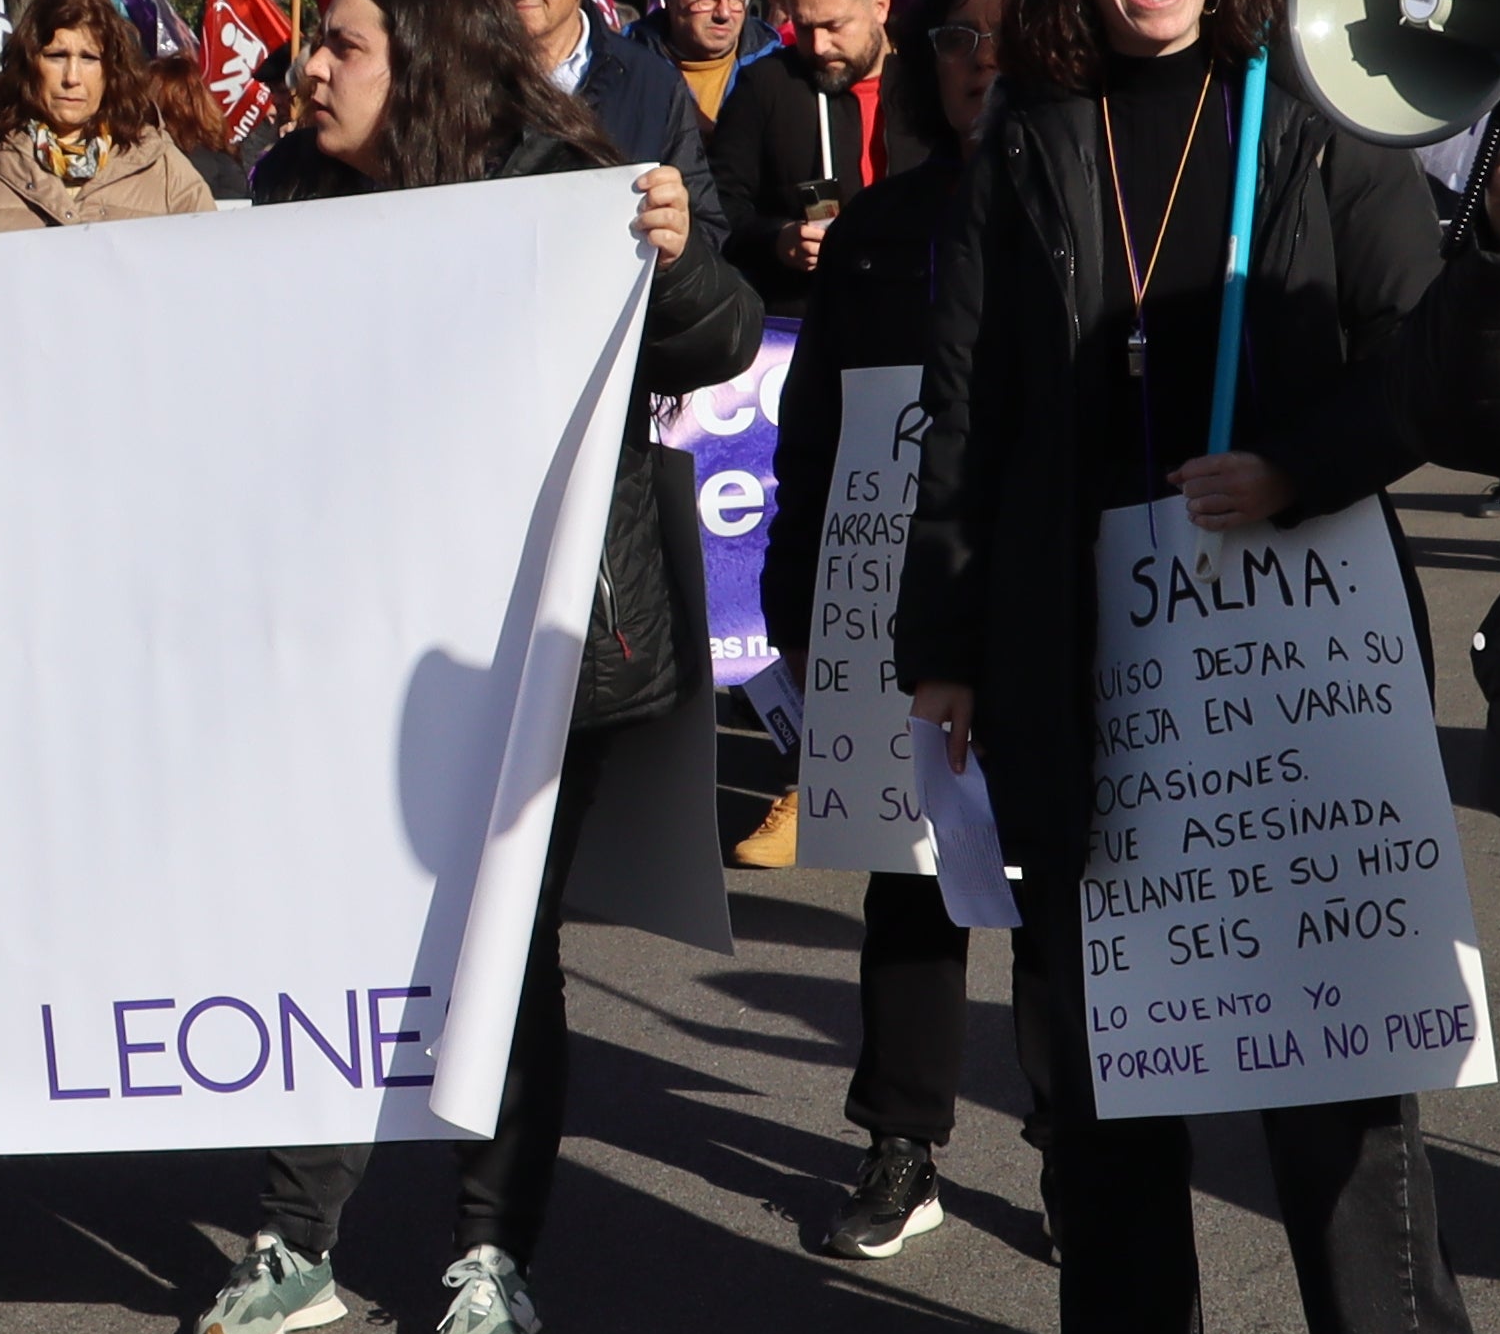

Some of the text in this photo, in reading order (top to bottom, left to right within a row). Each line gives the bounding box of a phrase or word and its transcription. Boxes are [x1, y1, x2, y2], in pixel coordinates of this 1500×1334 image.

[846, 470, 880, 502] ES
[1129, 547, 1358, 628] SALMA:
[1193, 631, 1404, 683] DEJAR A SU
[1205, 680, 1393, 735] EN VARIAS
[1095, 749, 1309, 817] OCASIONES.
[1182, 797, 1400, 855] ASESINADA
[1084, 836, 1439, 923] DELANTE DE SU HIJO
[1088, 897, 1421, 977] DE SEIS AÑOS.
[43, 983, 452, 1104] LEONE
